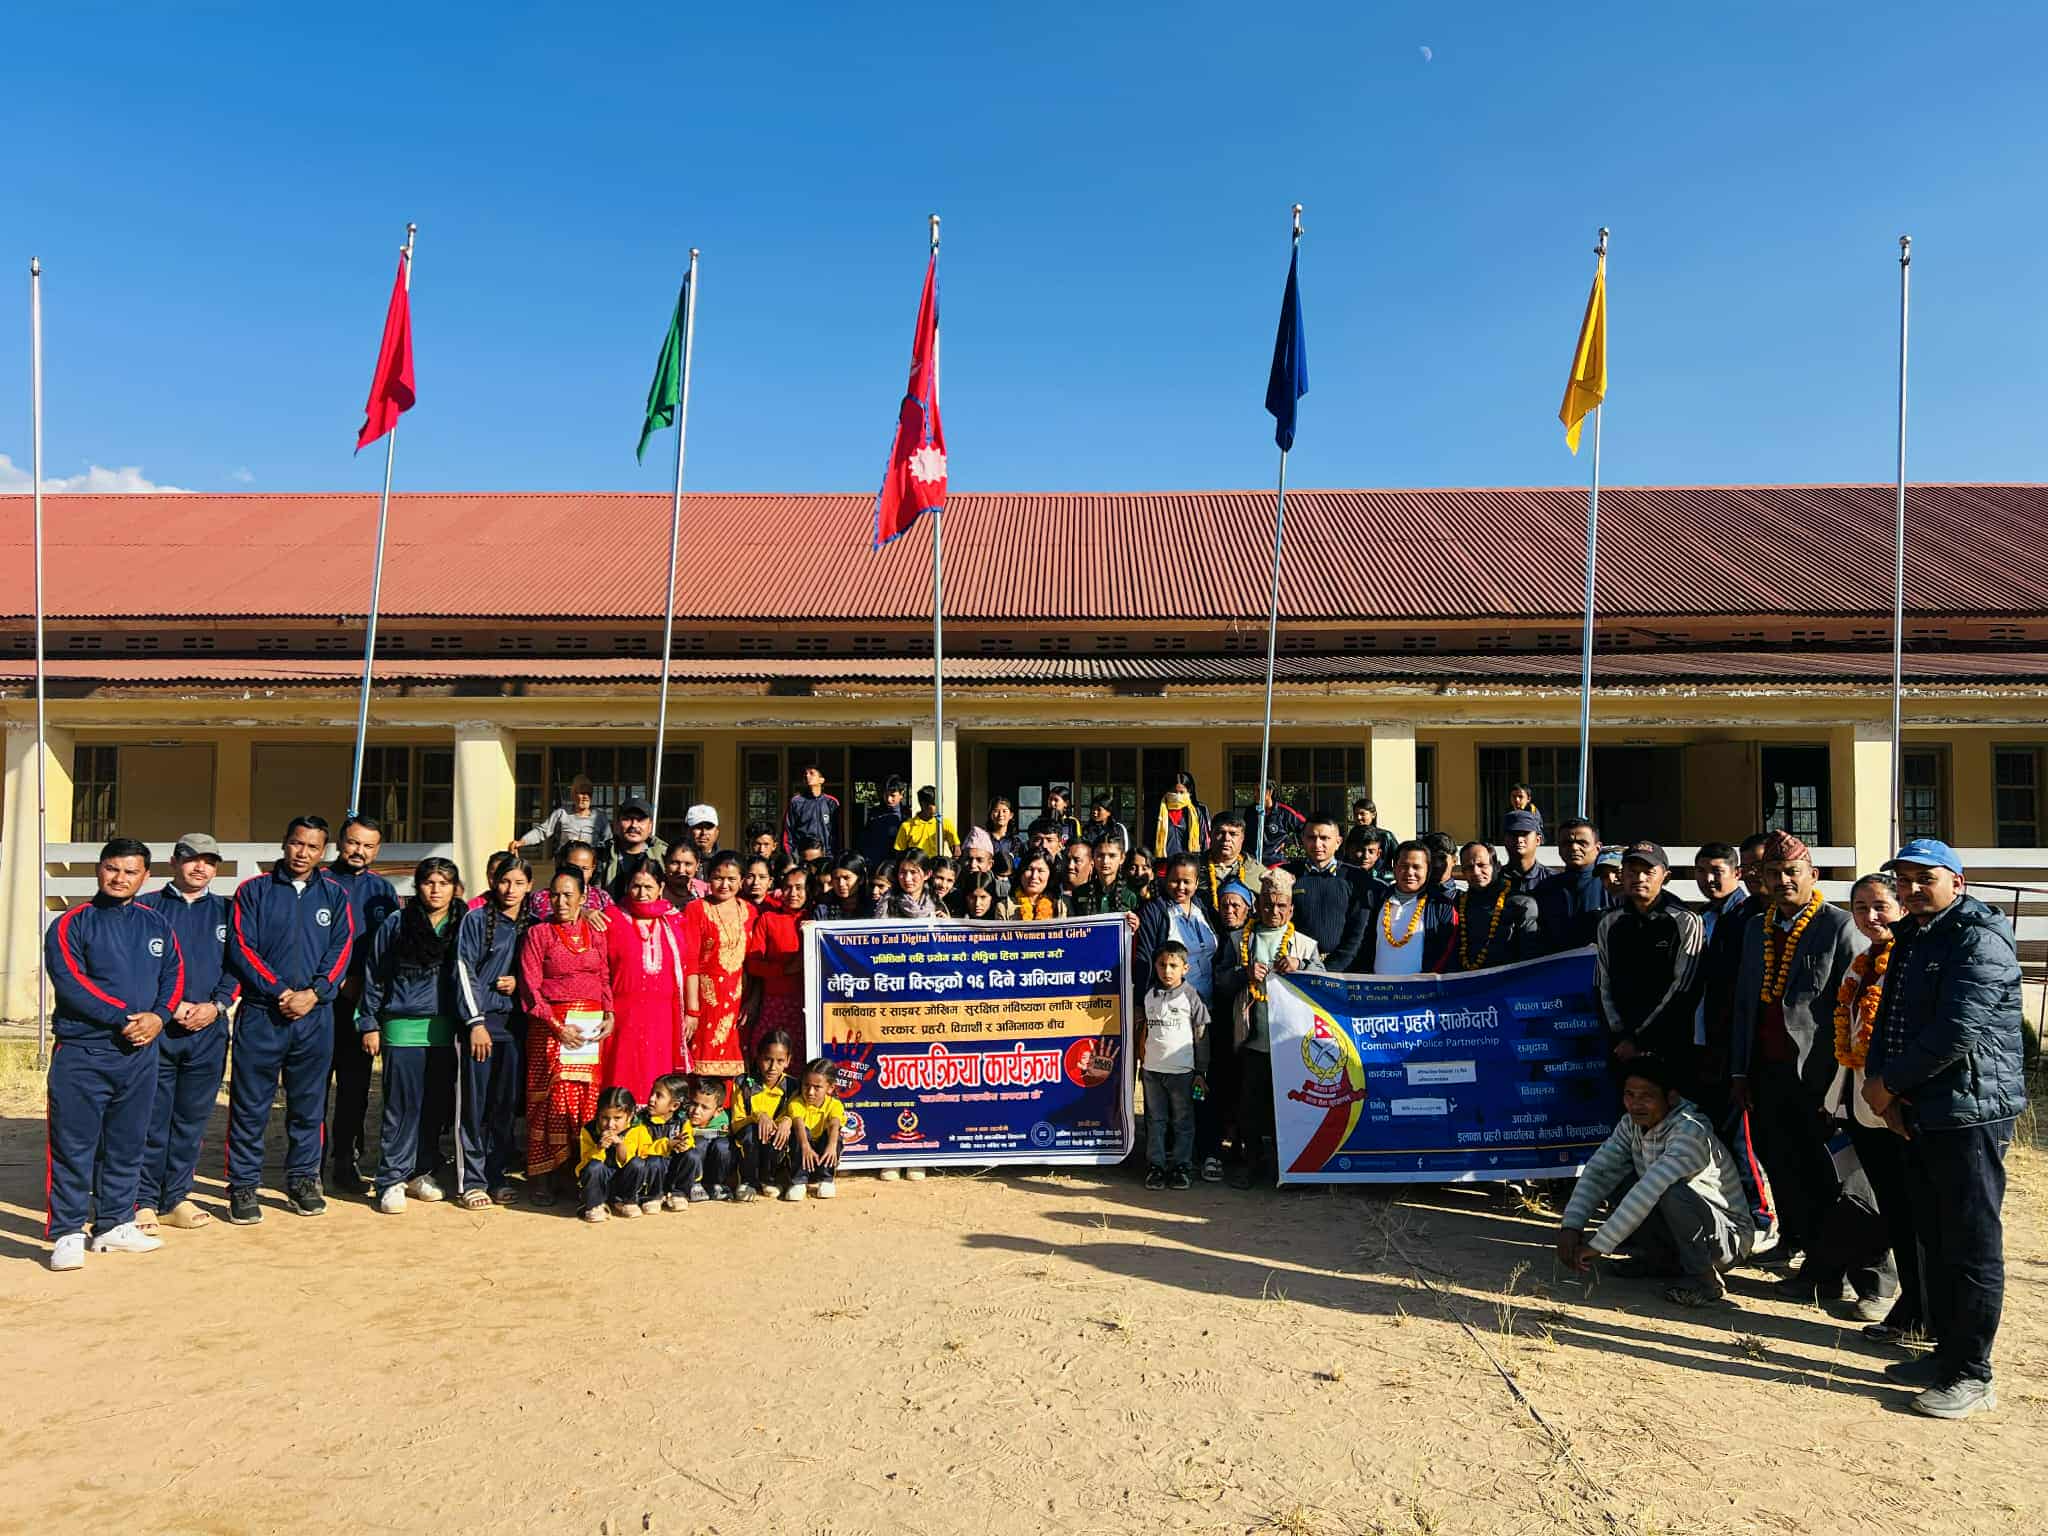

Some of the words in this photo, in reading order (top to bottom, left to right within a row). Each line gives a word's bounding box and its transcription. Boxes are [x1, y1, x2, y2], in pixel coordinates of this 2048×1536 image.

[834, 935, 869, 945] "UNITE
[872, 935, 880, 944] to
[882, 934, 899, 944] End
[901, 933, 930, 946] Digital
[932, 932, 967, 943] Violence
[969, 931, 998, 944] against
[1001, 930, 1013, 941] All
[1015, 930, 1045, 940] Women
[1048, 929, 1063, 939] and
[1065, 927, 1091, 938] Girls"
[827, 973, 870, 997] लैङ्गिक
[874, 972, 905, 992] हिंसा
[909, 971, 963, 993] विरुद्धको
[966, 974, 985, 989] १६
[989, 969, 1015, 988] दिने
[1019, 968, 1075, 987] अभियान
[1079, 970, 1112, 983] २०८२
[832, 1004, 876, 1017] बालविवाह
[880, 1007, 887, 1017] र
[889, 1006, 920, 1017] साइबर
[964, 1001, 999, 1016] सुरक्षित
[1003, 1000, 1046, 1013] भविष्यका
[1048, 999, 1073, 1011] लागि
[1076, 998, 1112, 1010] स्थानीय
[985, 1022, 994, 1033] र
[995, 1019, 1044, 1032] अभिभावक
[1047, 1018, 1065, 1029] बीच
[1351, 1009, 1435, 1037] समुदाय-प्रहरी
[1438, 1006, 1498, 1031] साझेदारी
[1361, 1038, 1443, 1051] Community-Police
[1446, 1036, 1499, 1048] Partnership
[877, 1043, 980, 1089] अन्तरक्रिया
[982, 1042, 1062, 1087] कार्यक्रम
